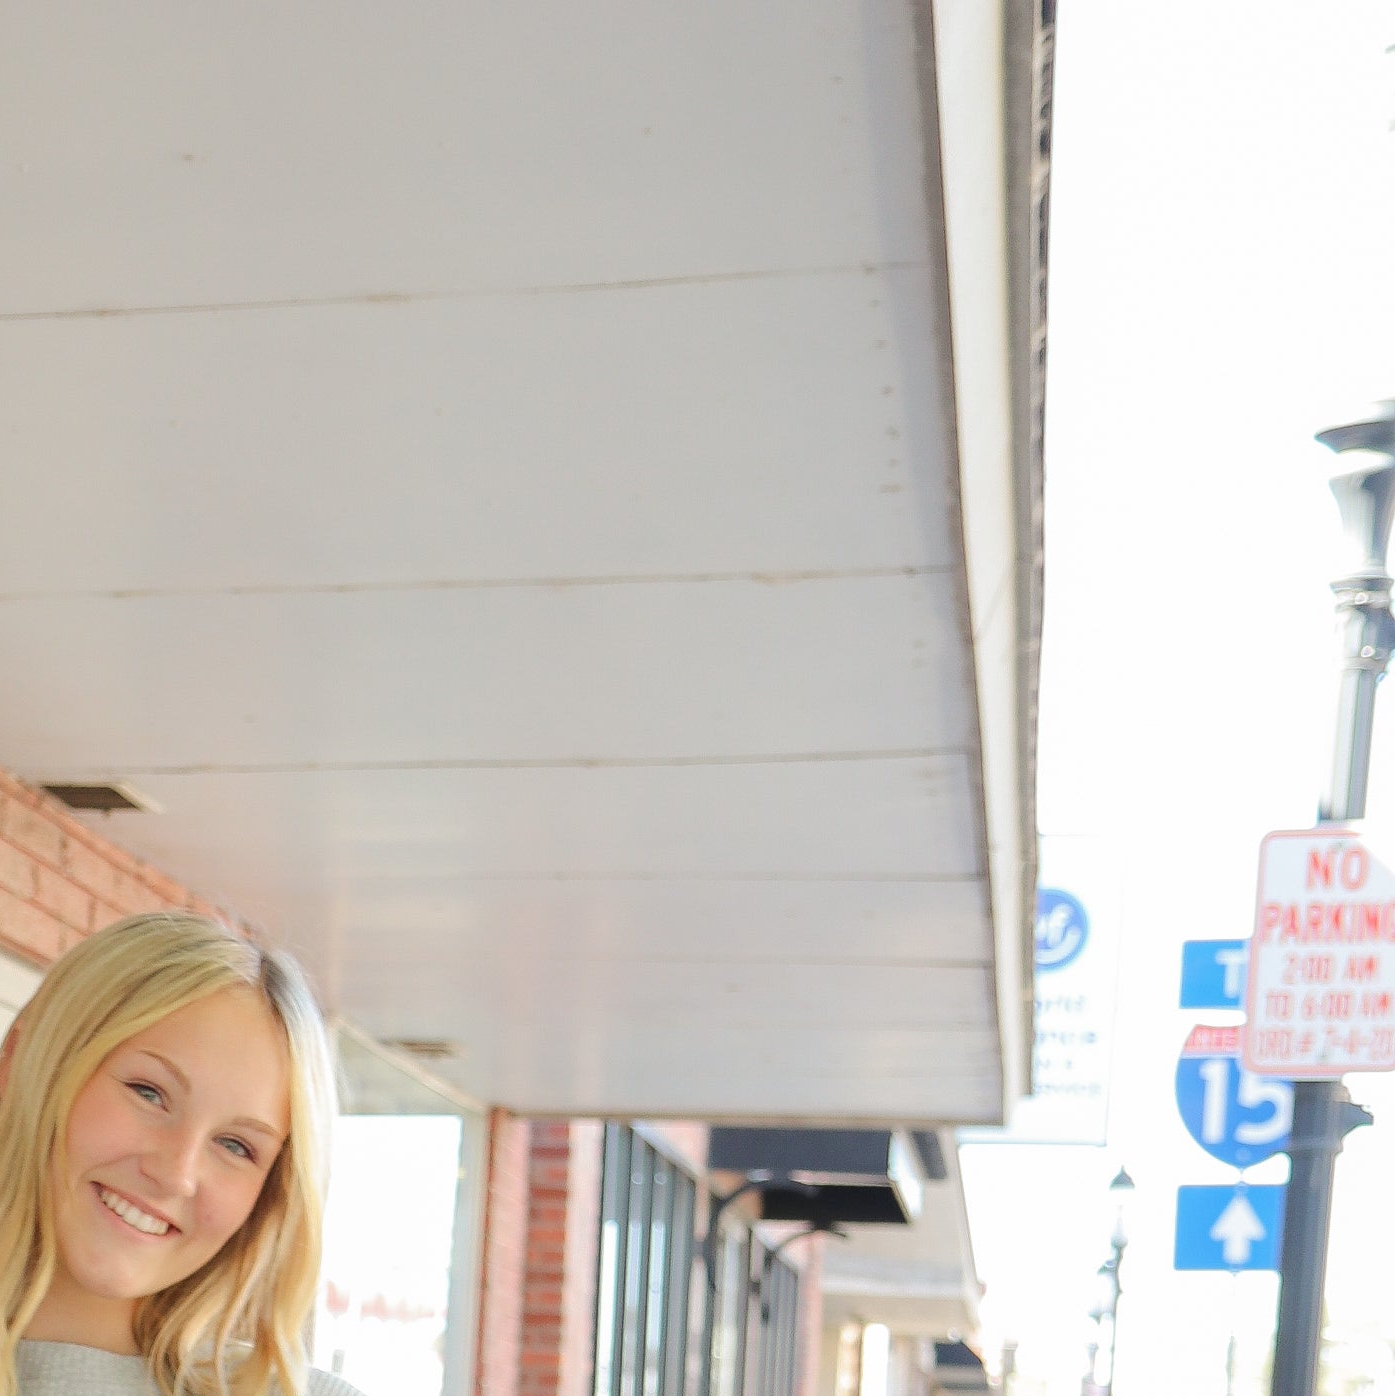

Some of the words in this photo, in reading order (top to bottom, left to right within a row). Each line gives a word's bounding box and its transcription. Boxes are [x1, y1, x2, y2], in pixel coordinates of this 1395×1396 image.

[1306, 847, 1369, 891] NO
[1343, 953, 1379, 982] AM
[1265, 991, 1294, 1019] TO
[1361, 990, 1392, 1016] AM
[1199, 1061, 1294, 1146] 15
